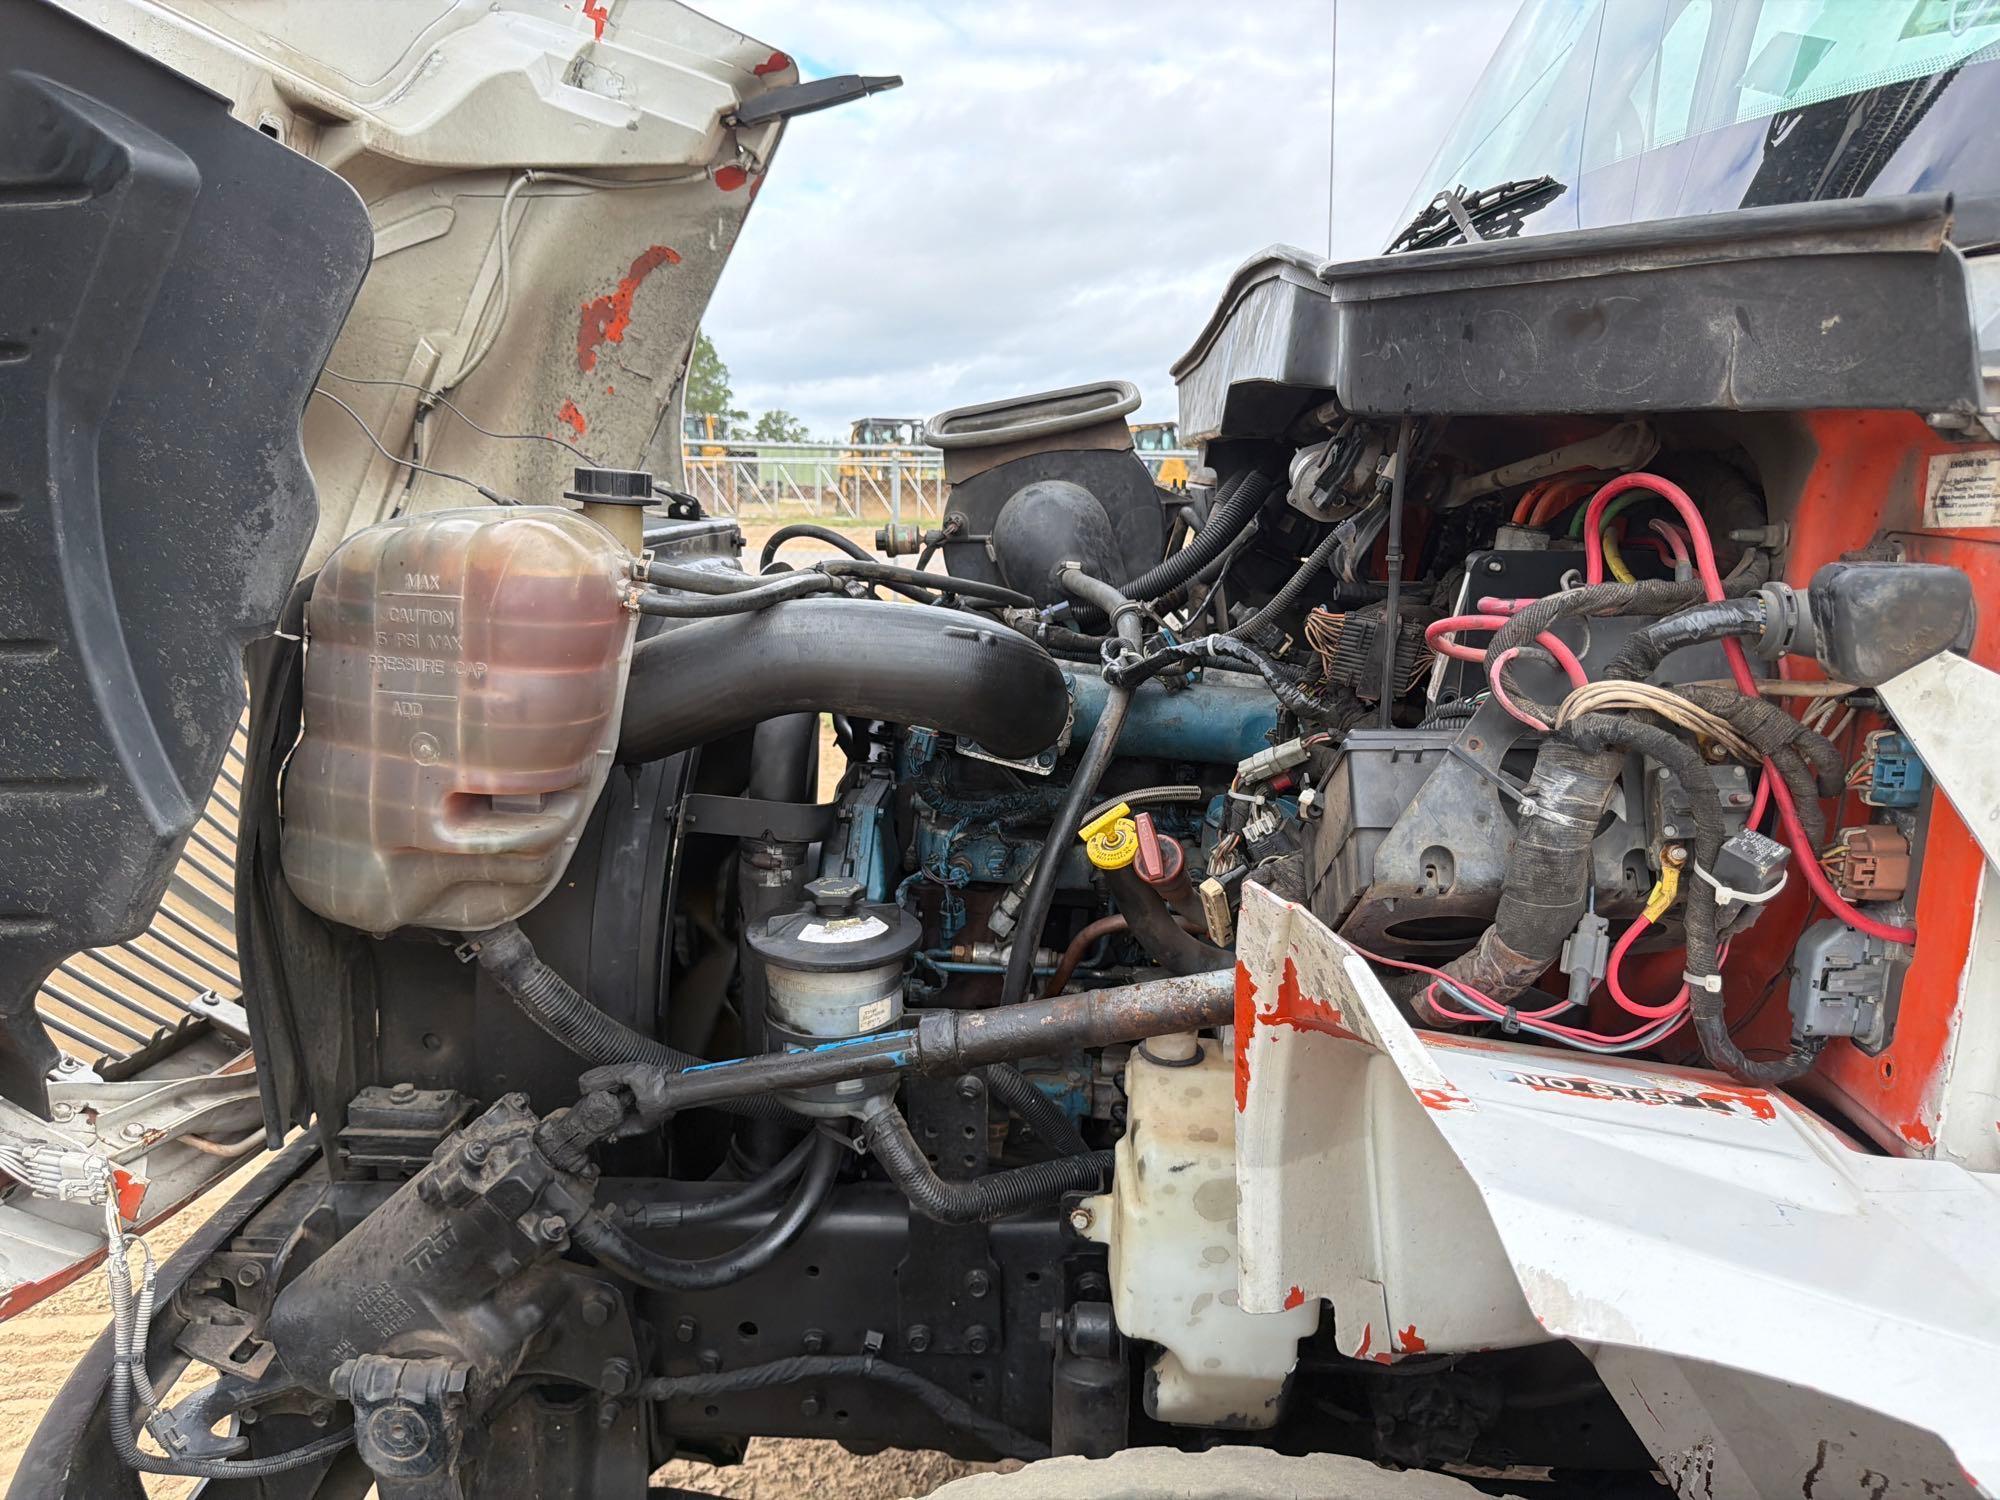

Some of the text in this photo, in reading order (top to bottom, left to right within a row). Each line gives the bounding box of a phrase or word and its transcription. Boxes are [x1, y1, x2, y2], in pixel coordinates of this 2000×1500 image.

[404, 572, 440, 592] MAX
[388, 607, 455, 628] CAUTION
[395, 632, 420, 648] PSI
[427, 634, 463, 650] MAX
[369, 655, 488, 680] PRESSURE CAP
[391, 701, 424, 718] ADD
[1514, 1073, 1574, 1089] NO
[1588, 1084, 1682, 1104] STEP
